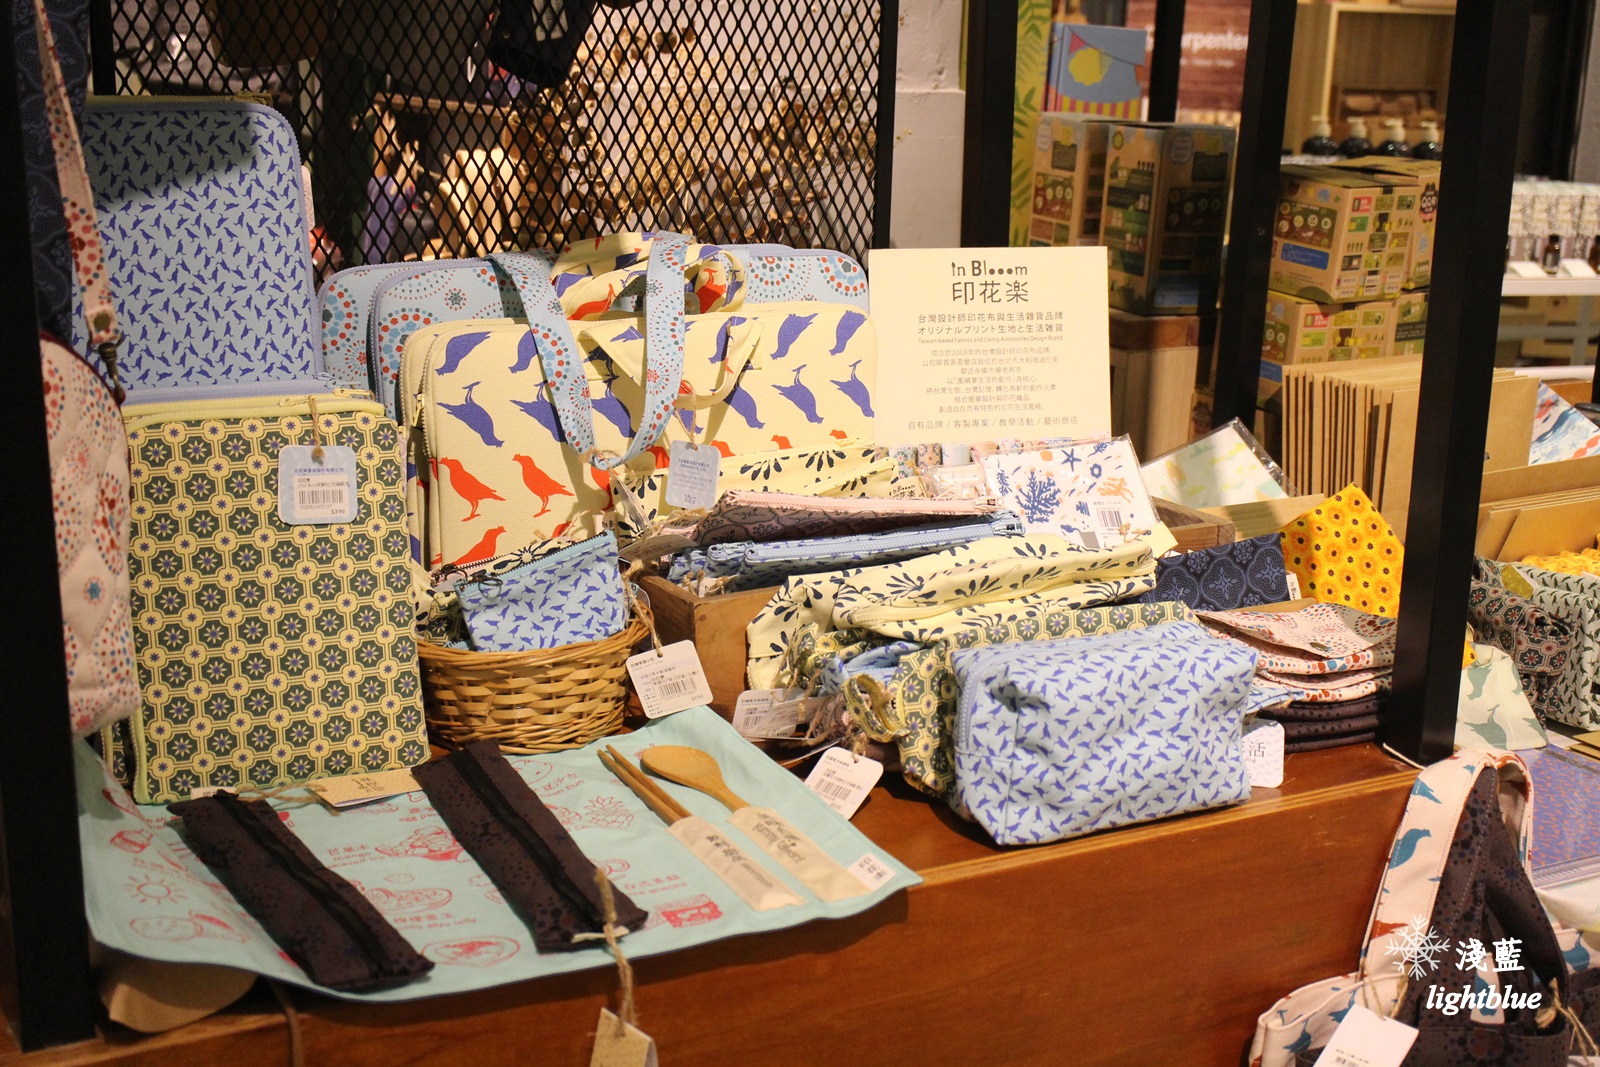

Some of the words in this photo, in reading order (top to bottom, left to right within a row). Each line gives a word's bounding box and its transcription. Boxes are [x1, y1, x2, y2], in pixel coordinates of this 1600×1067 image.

[918, 311, 1064, 324] 台灣設計師印花布與生活雜貨品牌
[984, 336, 1000, 344] Living
[908, 420, 944, 430] 自有品牌
[999, 417, 1035, 427] 教學活動
[567, 779, 585, 790] bun
